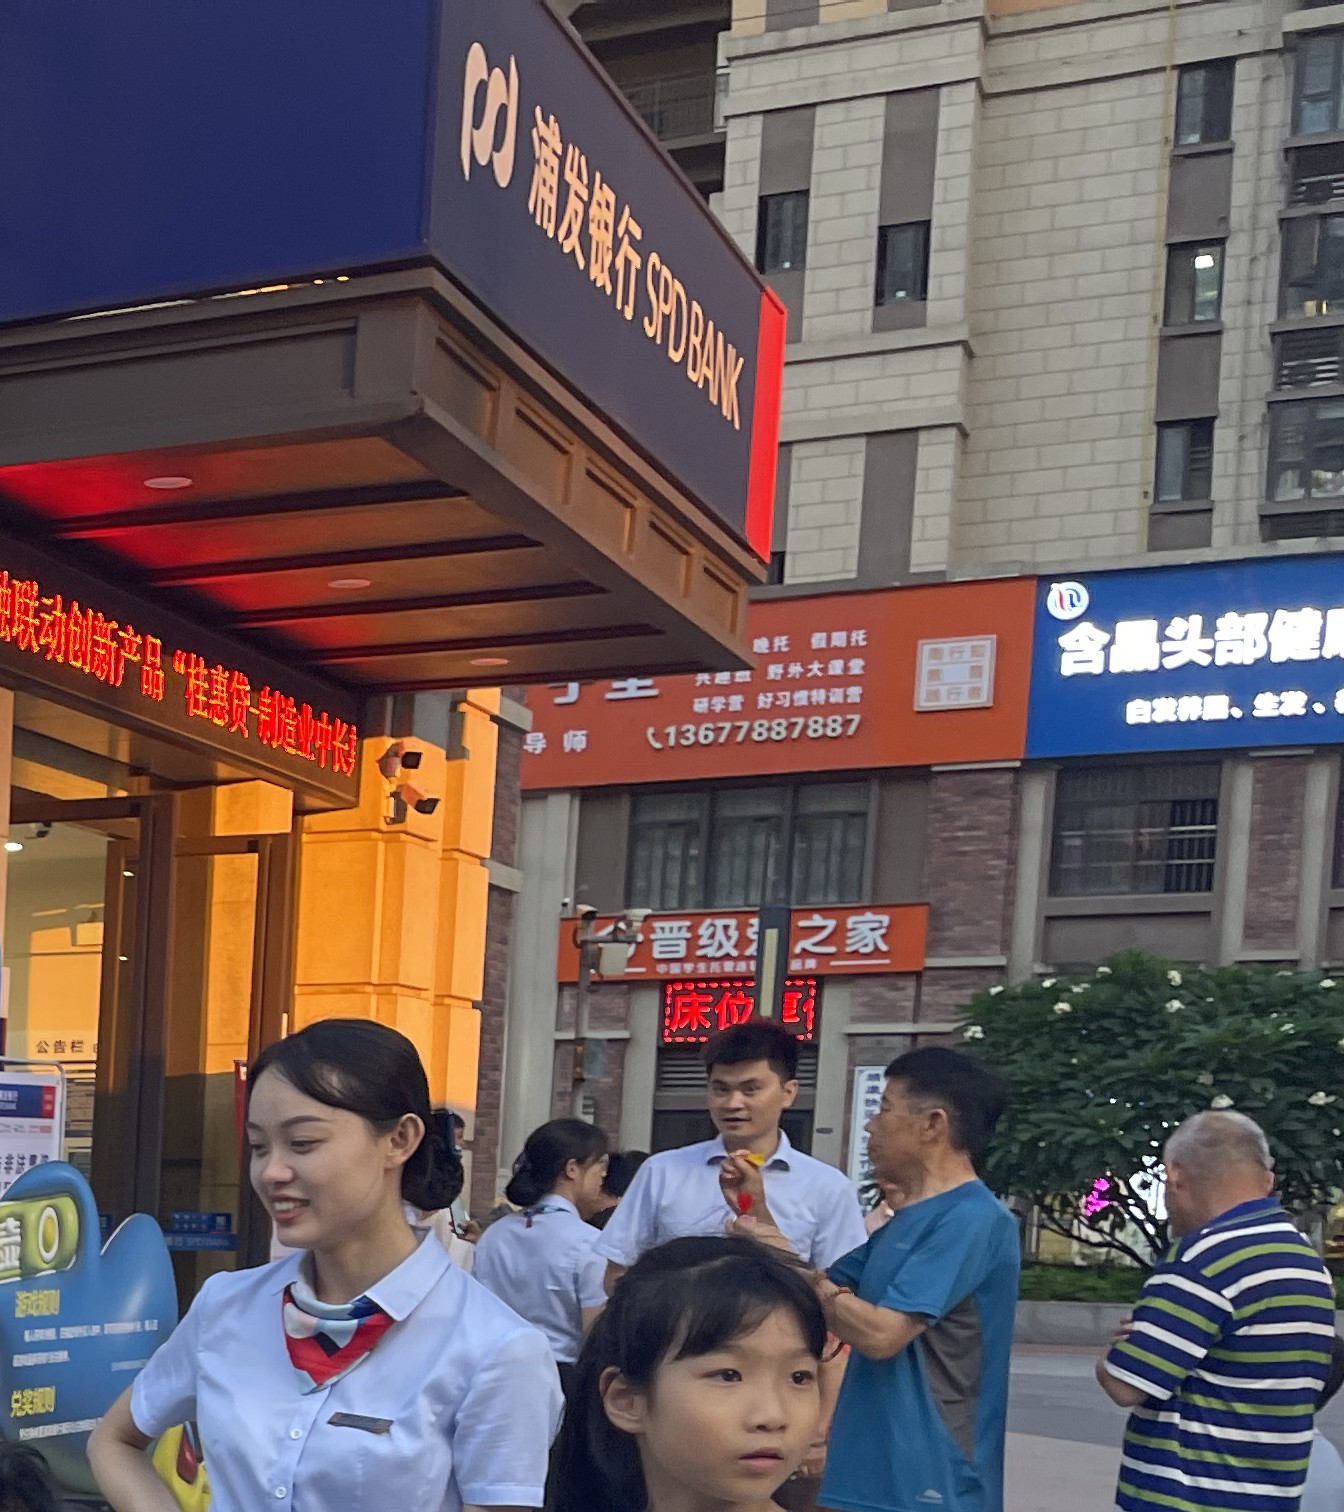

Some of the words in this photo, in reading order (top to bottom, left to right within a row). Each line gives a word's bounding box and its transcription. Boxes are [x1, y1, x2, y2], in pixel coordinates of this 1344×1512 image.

[528, 106, 643, 322] 浦发银行
[644, 252, 686, 364] SPD
[687, 306, 745, 430] BANK
[663, 714, 862, 748] 13677887887
[649, 912, 891, 960] 晋级之家
